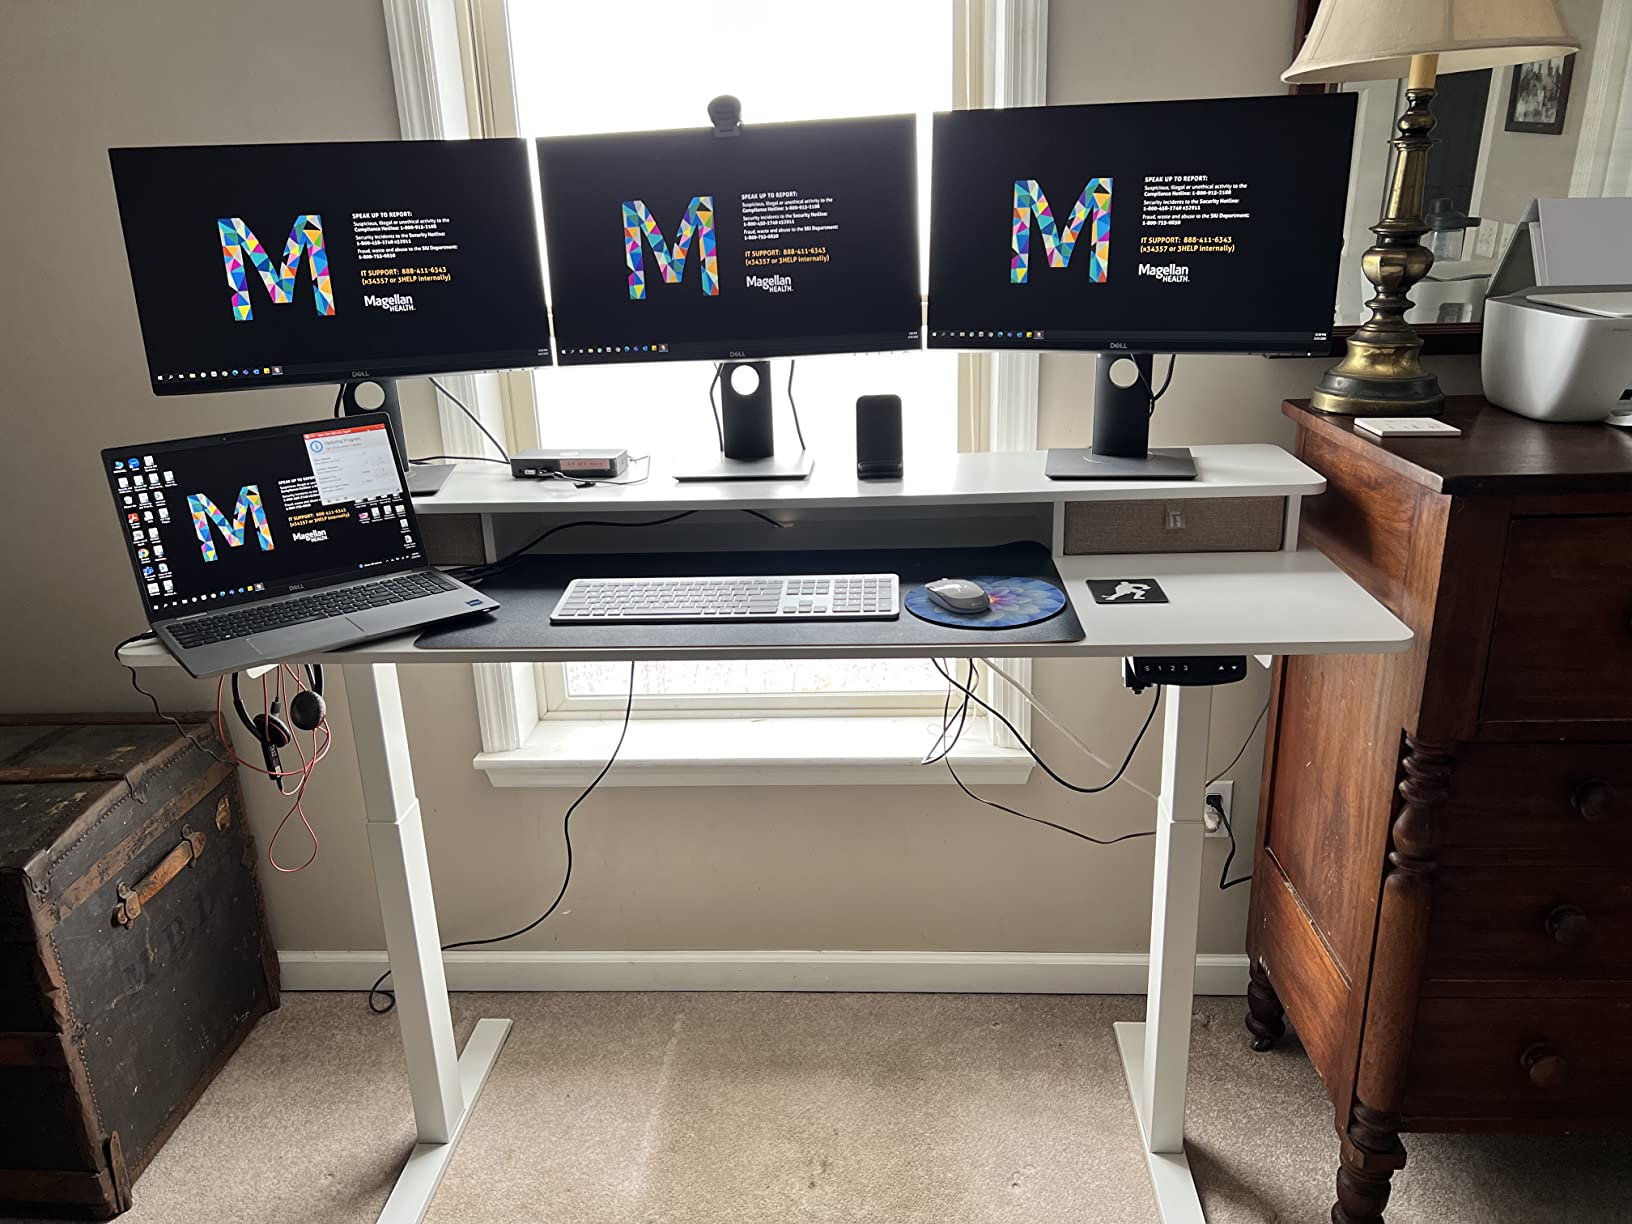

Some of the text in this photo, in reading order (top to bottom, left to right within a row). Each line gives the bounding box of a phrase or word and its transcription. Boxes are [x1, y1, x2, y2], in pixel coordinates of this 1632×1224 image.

[1011, 178, 1113, 283] M
[622, 196, 719, 299] M
[783, 247, 825, 255] 888-411-6343
[1140, 245, 1167, 253] (x34357
[1199, 244, 1234, 253] internally)
[745, 258, 770, 266] (x34357
[798, 254, 829, 262] internally)
[218, 215, 335, 321] M
[368, 268, 399, 276] SUPPORT:
[401, 266, 446, 274] 888-411-6343
[1138, 263, 1188, 279] Magellan
[361, 277, 388, 285] (x34357
[398, 275, 417, 283] 3HELP
[418, 273, 450, 281] internally)
[746, 274, 791, 289] Magellan
[364, 293, 413, 309] Magellan
[187, 485, 274, 562] M
[292, 529, 327, 541] Magellan
[289, 583, 304, 591] DELL
